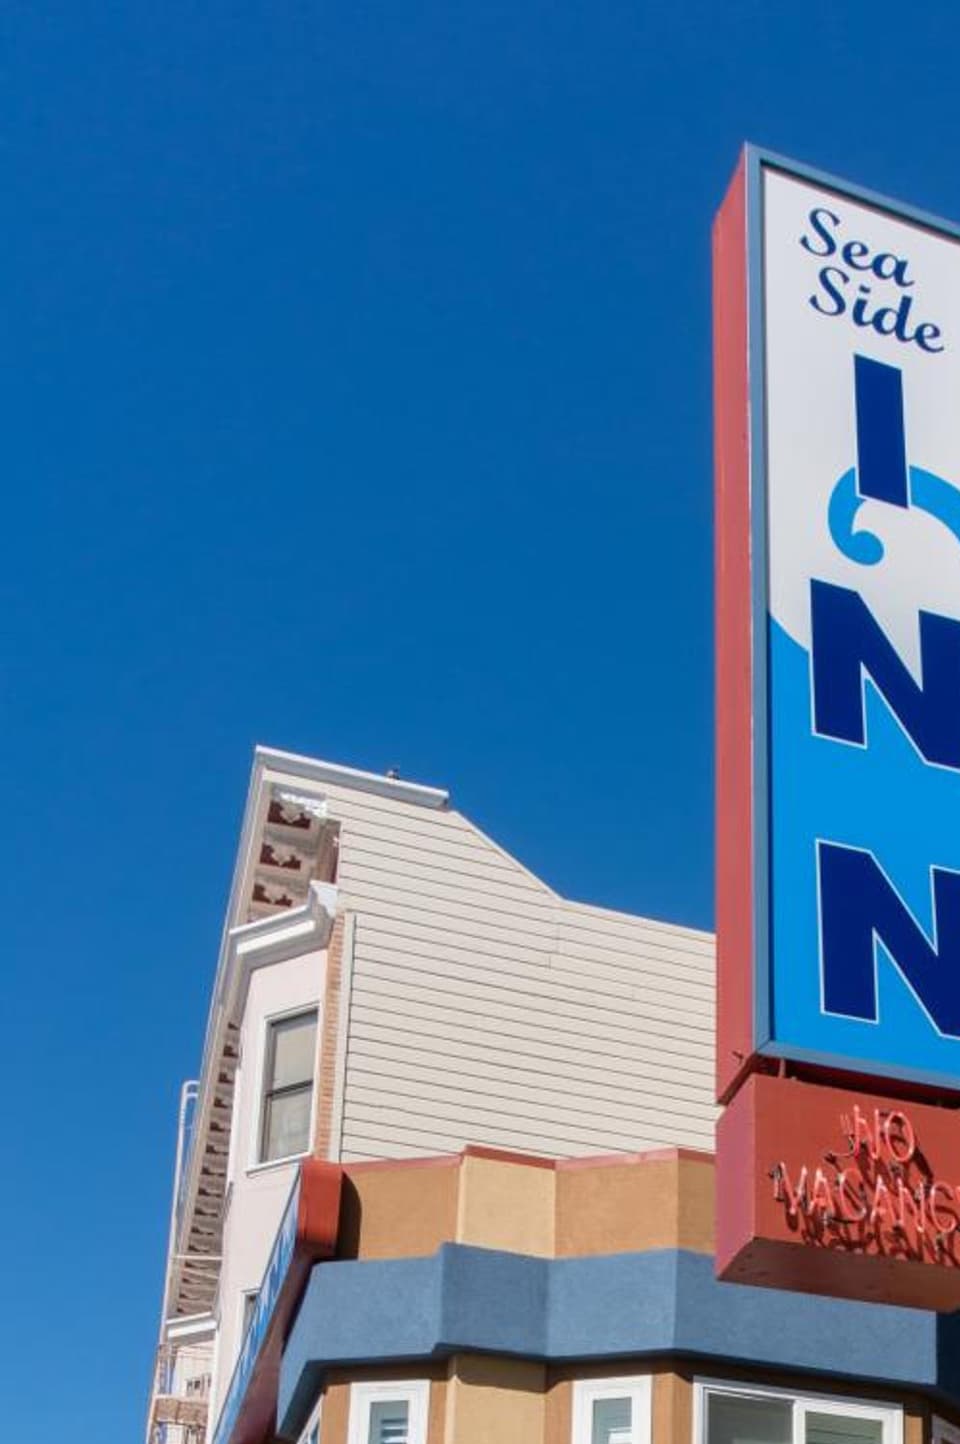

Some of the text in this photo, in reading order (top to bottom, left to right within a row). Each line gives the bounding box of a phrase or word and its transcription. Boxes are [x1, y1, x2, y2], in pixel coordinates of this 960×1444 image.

[799, 207, 916, 288] Sea
[808, 266, 945, 353] Side
[852, 1104, 915, 1163] NO
